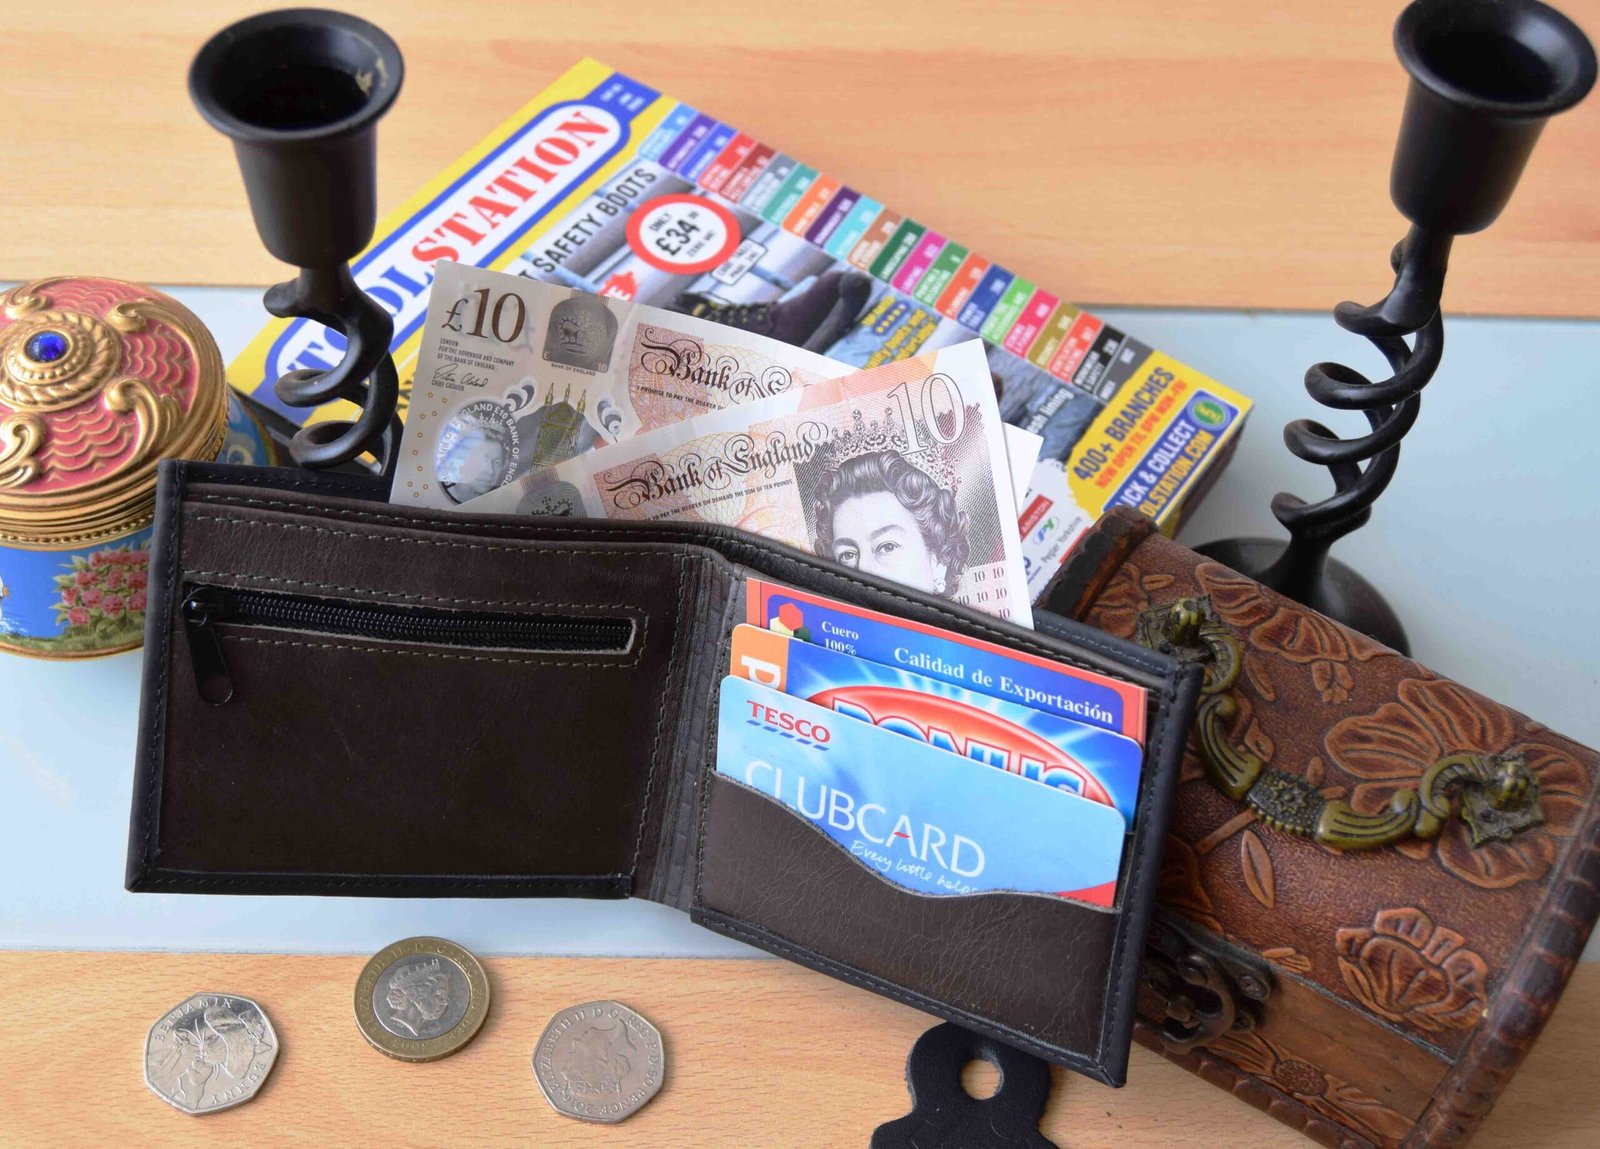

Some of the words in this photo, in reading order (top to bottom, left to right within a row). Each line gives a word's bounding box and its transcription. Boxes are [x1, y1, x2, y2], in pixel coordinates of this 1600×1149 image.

[532, 213, 603, 273] SAFETY
[596, 168, 657, 217] BOOTS
[656, 219, 701, 256] £34
[441, 288, 526, 343] £10
[438, 345, 449, 353] FOR
[448, 346, 457, 355] THE
[458, 349, 482, 360] GOVERNOR
[483, 354, 493, 362] AND
[493, 356, 515, 367] COMPANY
[440, 337, 459, 347] LONDON
[437, 352, 444, 360] OF
[444, 353, 453, 362] THE
[454, 355, 467, 365] BANK
[467, 358, 474, 366] OF
[473, 360, 495, 371] ENGLAND
[572, 367, 597, 377] ENGLAND
[641, 328, 739, 391] Bank
[431, 380, 445, 388] CHIEF
[445, 382, 465, 392] CASHIER
[640, 386, 665, 397] PROMISE
[665, 391, 673, 399] TO
[673, 393, 684, 401] PAY
[684, 396, 694, 404] THE
[695, 400, 717, 410] BEARER
[494, 406, 508, 420] £10
[886, 372, 966, 456] 10
[1025, 403, 1050, 431] esh
[1041, 387, 1076, 418] lining
[1072, 440, 1114, 481] 400+
[1104, 366, 1175, 442] BRANCHES
[505, 419, 520, 445] BANK
[1147, 419, 1196, 472] COLLECT
[512, 447, 520, 461] OF
[603, 452, 702, 510] Bank
[721, 421, 829, 479] England
[501, 462, 518, 487] ENGL
[1139, 428, 1216, 517] OLSTATION.COM
[1139, 467, 1158, 485] &
[660, 511, 670, 519] PAY
[670, 508, 681, 516] THE
[681, 502, 703, 513] BEARER
[711, 493, 734, 504] DEMAND
[734, 490, 745, 499] THE
[744, 488, 756, 496] SUM
[773, 479, 793, 489] POUNDS
[1117, 481, 1149, 511] ICK
[973, 570, 986, 583] 10
[992, 567, 1005, 579] 10
[976, 591, 989, 603] 10
[995, 587, 1008, 600] 10
[999, 608, 1010, 620] 10
[821, 620, 859, 642] Cuero
[824, 637, 857, 656] 100%
[893, 647, 964, 680] Calidad
[971, 670, 993, 688] de
[1000, 676, 1113, 725] Exportación
[746, 699, 831, 743] TESCO
[745, 760, 985, 879] CLUBCARD
[850, 839, 892, 873] Every
[896, 858, 932, 883] little
[155, 997, 234, 1043] BENJAMIN
[210, 1061, 266, 1104] BUNNY
[540, 1018, 572, 1093] ELIZABETH
[599, 1087, 648, 1115] PENCE
